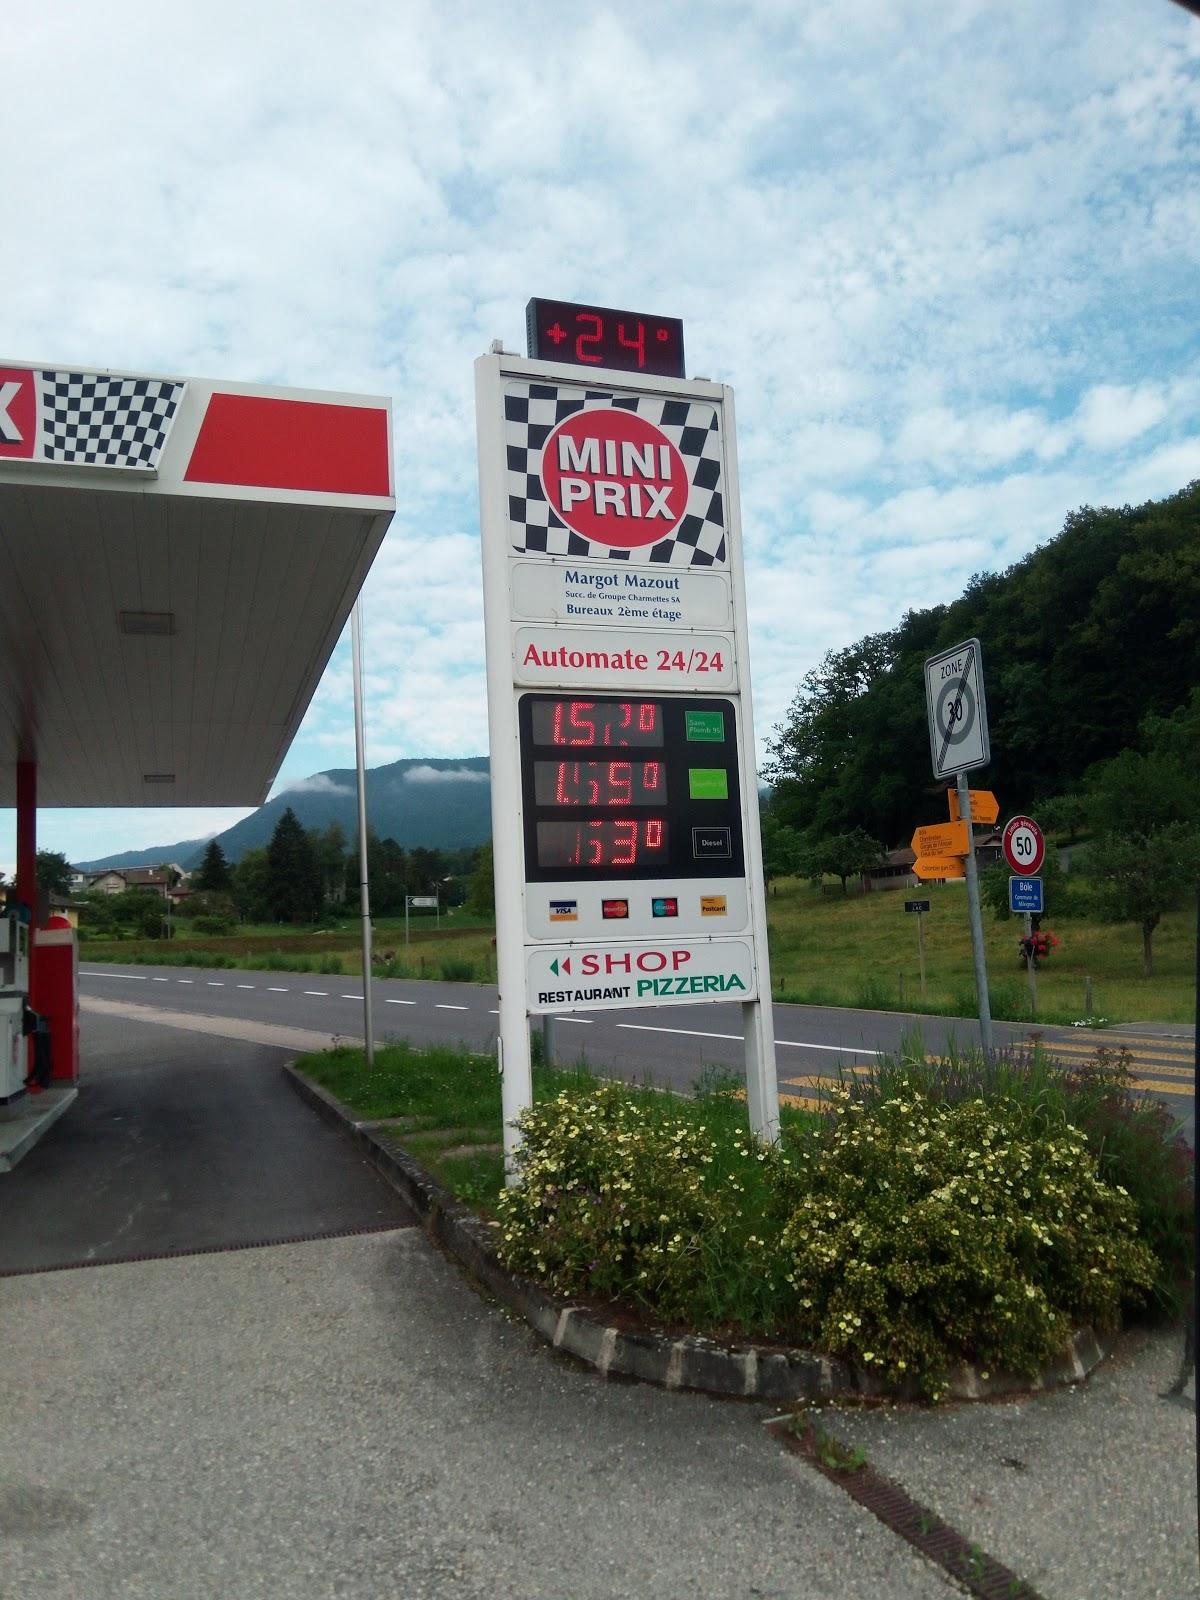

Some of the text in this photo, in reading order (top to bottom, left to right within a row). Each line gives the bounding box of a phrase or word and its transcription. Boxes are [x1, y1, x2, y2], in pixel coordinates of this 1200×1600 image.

[558, 434, 672, 480] MINI
[560, 477, 676, 520] PRIX
[565, 571, 680, 590] Margot Mazout
[565, 590, 586, 598] Succ.
[587, 591, 596, 599] de
[598, 592, 626, 602] Groupe
[628, 594, 669, 603] Charmettes
[566, 604, 682, 622] Bureaux 2ème étage
[523, 643, 724, 674] Automate 24/24
[940, 658, 963, 679] ZONE
[947, 700, 963, 723] 30
[689, 719, 706, 727] Sans
[701, 839, 722, 847] Diesel
[1016, 836, 1032, 856] 50
[581, 950, 691, 976] SHOP
[538, 986, 631, 1004] RESTAURANT
[637, 973, 746, 997] PIZZERIA
